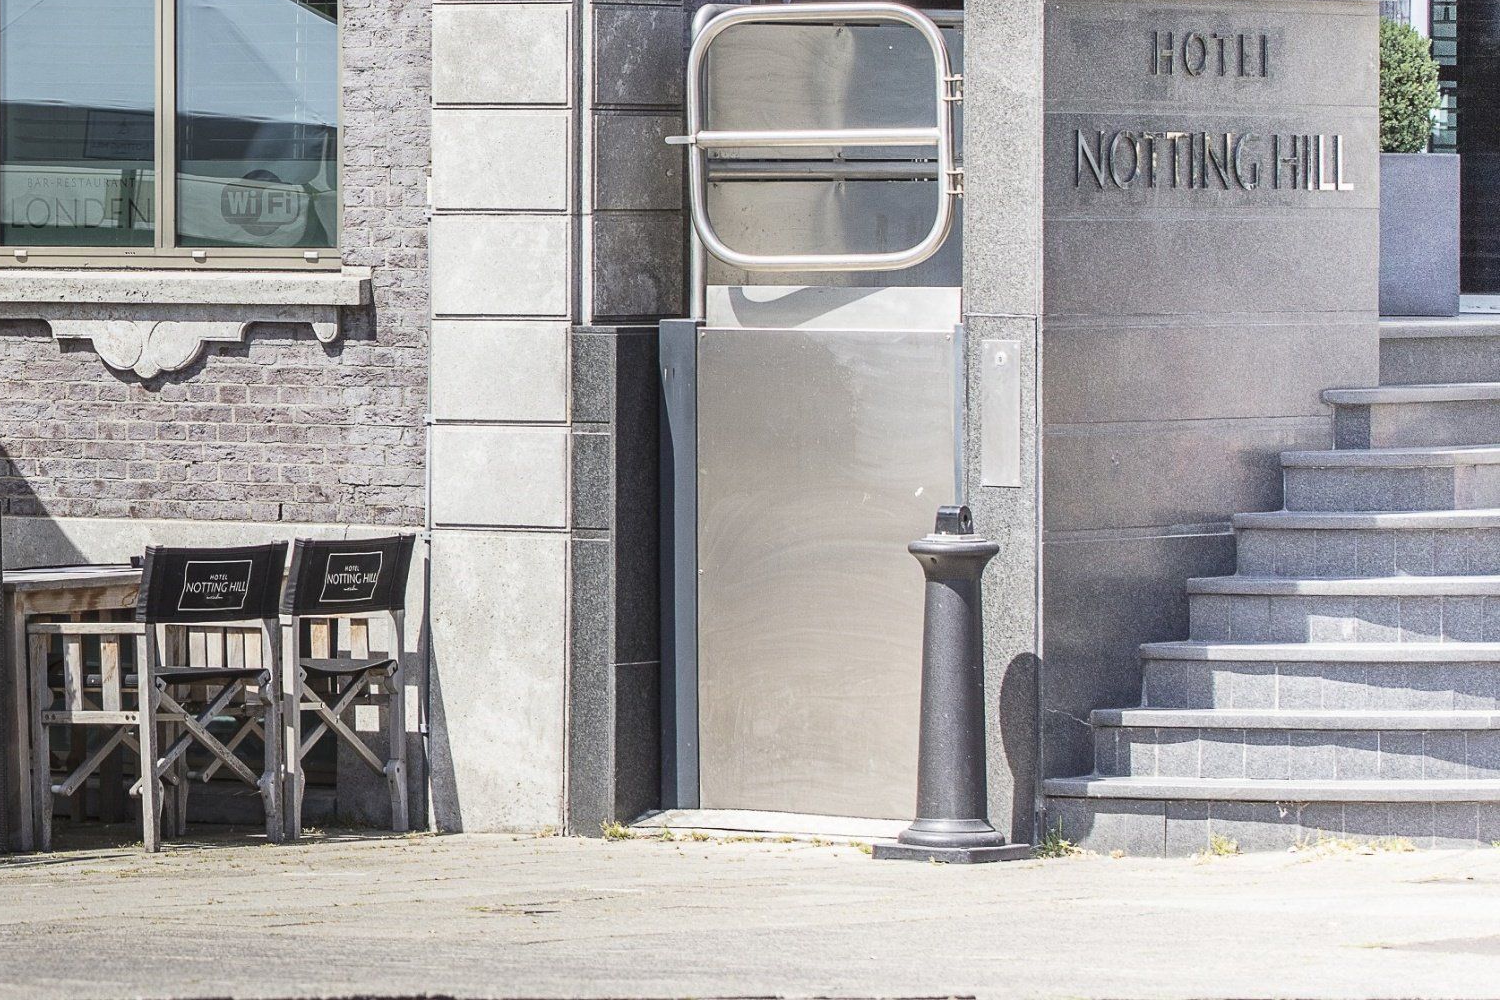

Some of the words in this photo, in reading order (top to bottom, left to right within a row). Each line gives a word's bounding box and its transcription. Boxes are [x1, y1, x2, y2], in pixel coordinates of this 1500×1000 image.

[1076, 129, 1262, 191] NOTTING
[1272, 134, 1355, 191] HILL
[27, 177, 136, 188] BAR-RESTAURANT
[11, 197, 150, 229] LONDEN
[327, 573, 362, 585] NOTTING
[363, 572, 377, 583] HILL
[186, 581, 229, 593] NOTTING
[228, 581, 246, 592] HILL
